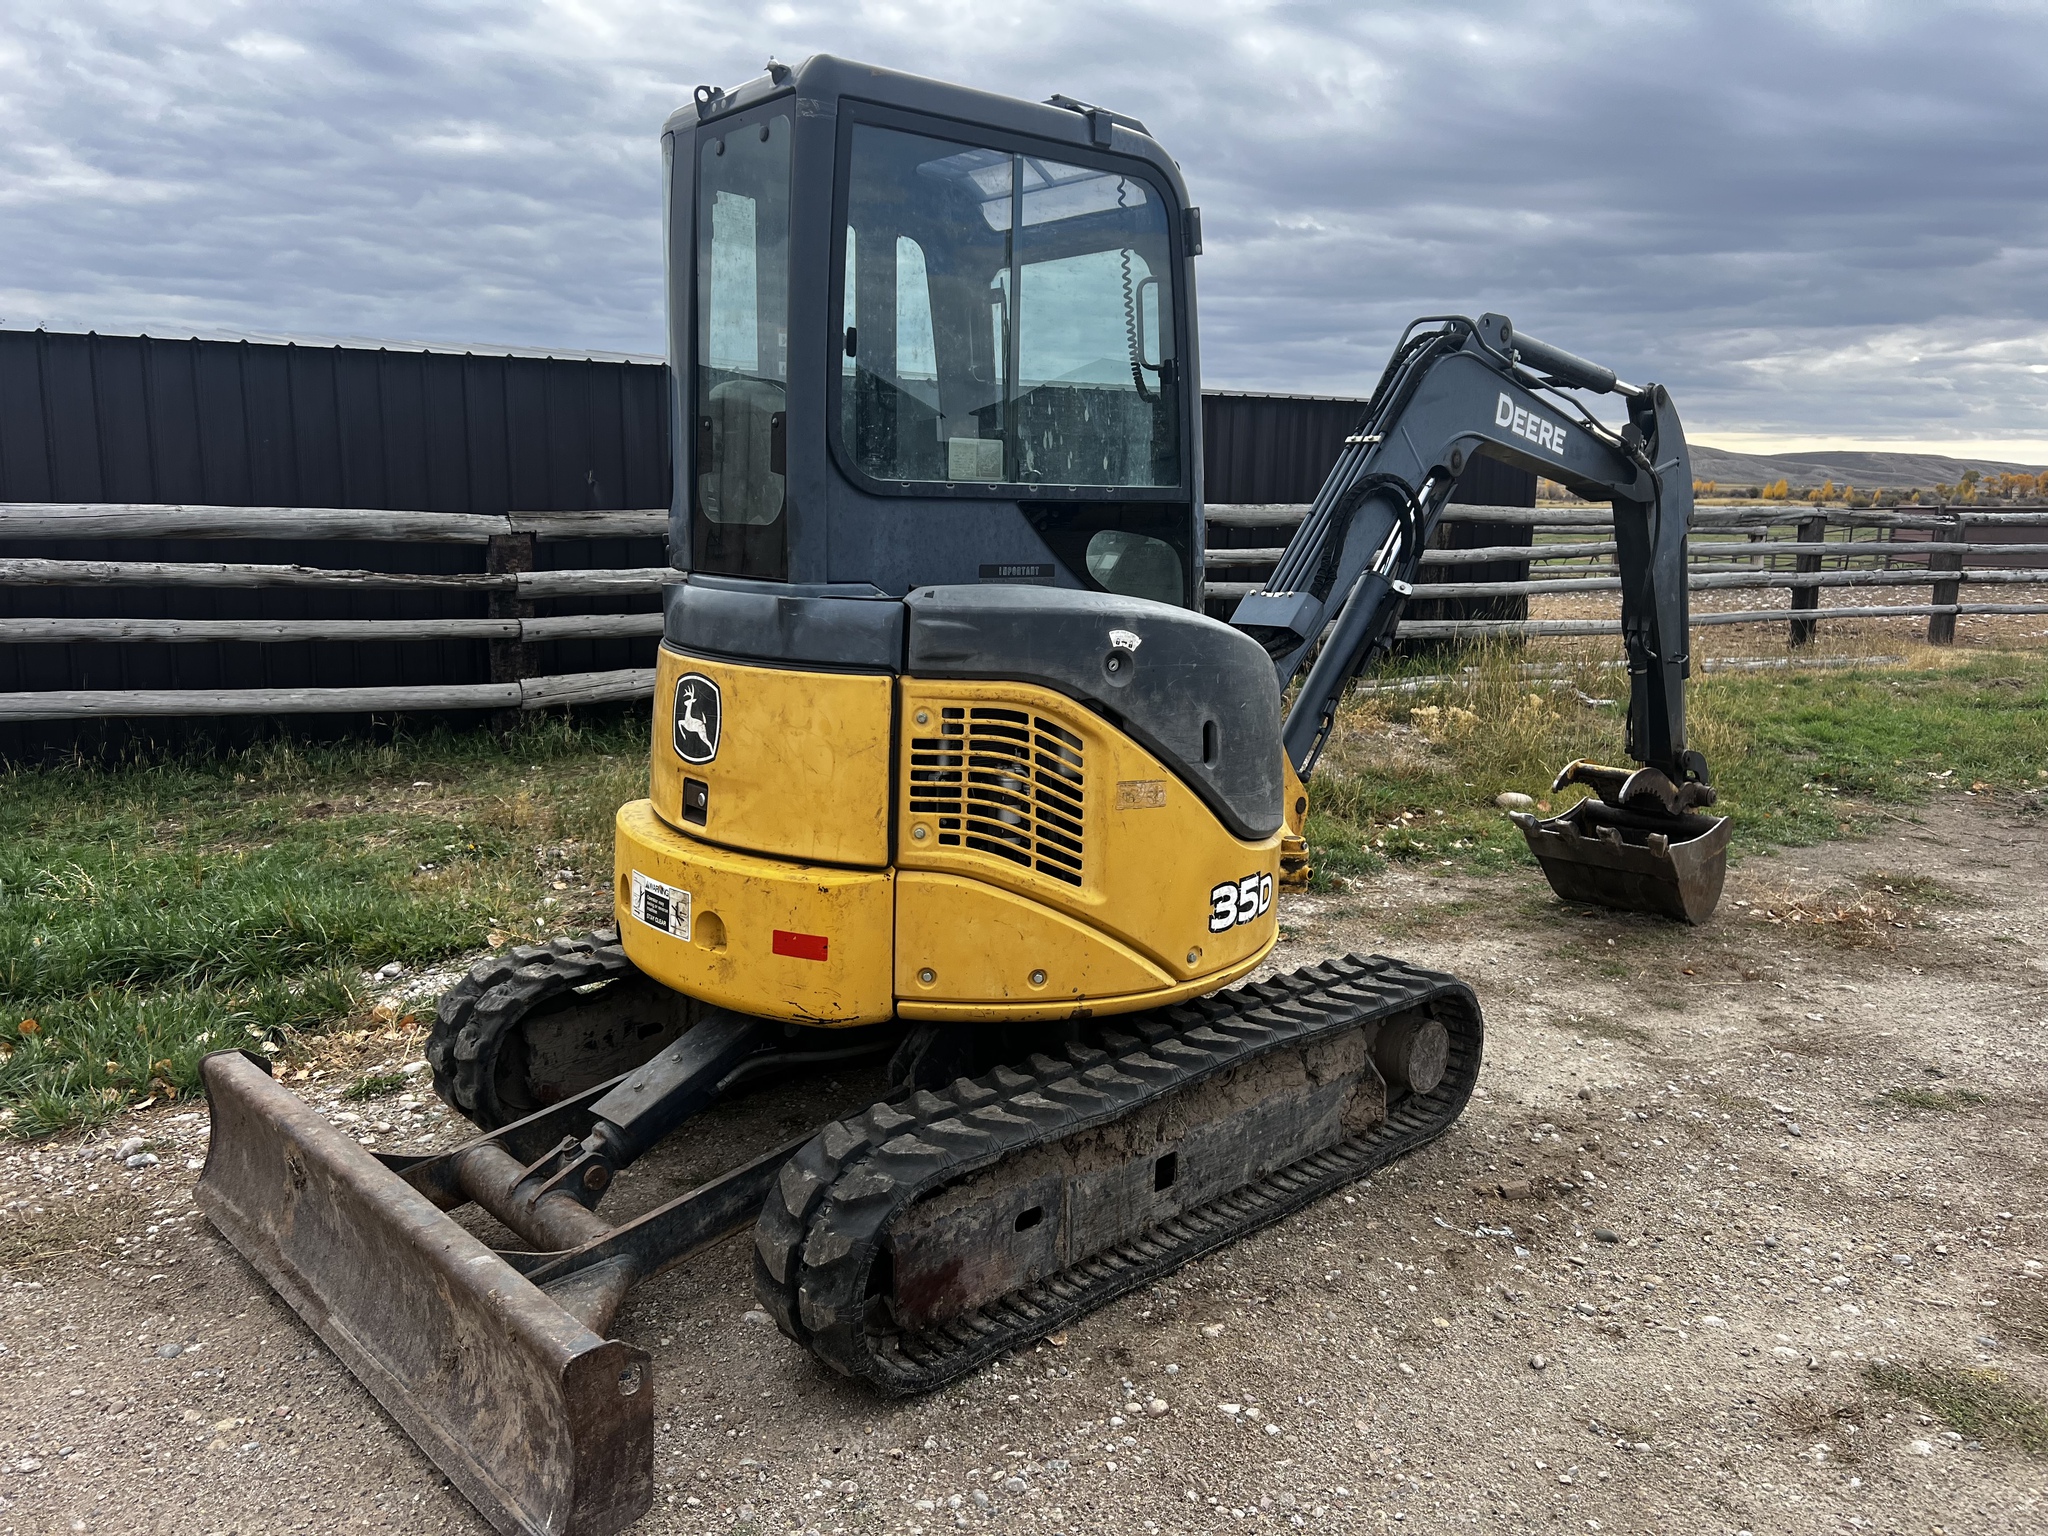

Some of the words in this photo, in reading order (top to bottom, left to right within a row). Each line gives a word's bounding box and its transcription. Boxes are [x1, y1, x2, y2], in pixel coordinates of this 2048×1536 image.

[1495, 392, 1567, 455] DEERE
[998, 566, 1040, 576] IMPORTANT
[1208, 870, 1273, 934] 35D
[655, 917, 667, 927] CLEAR
